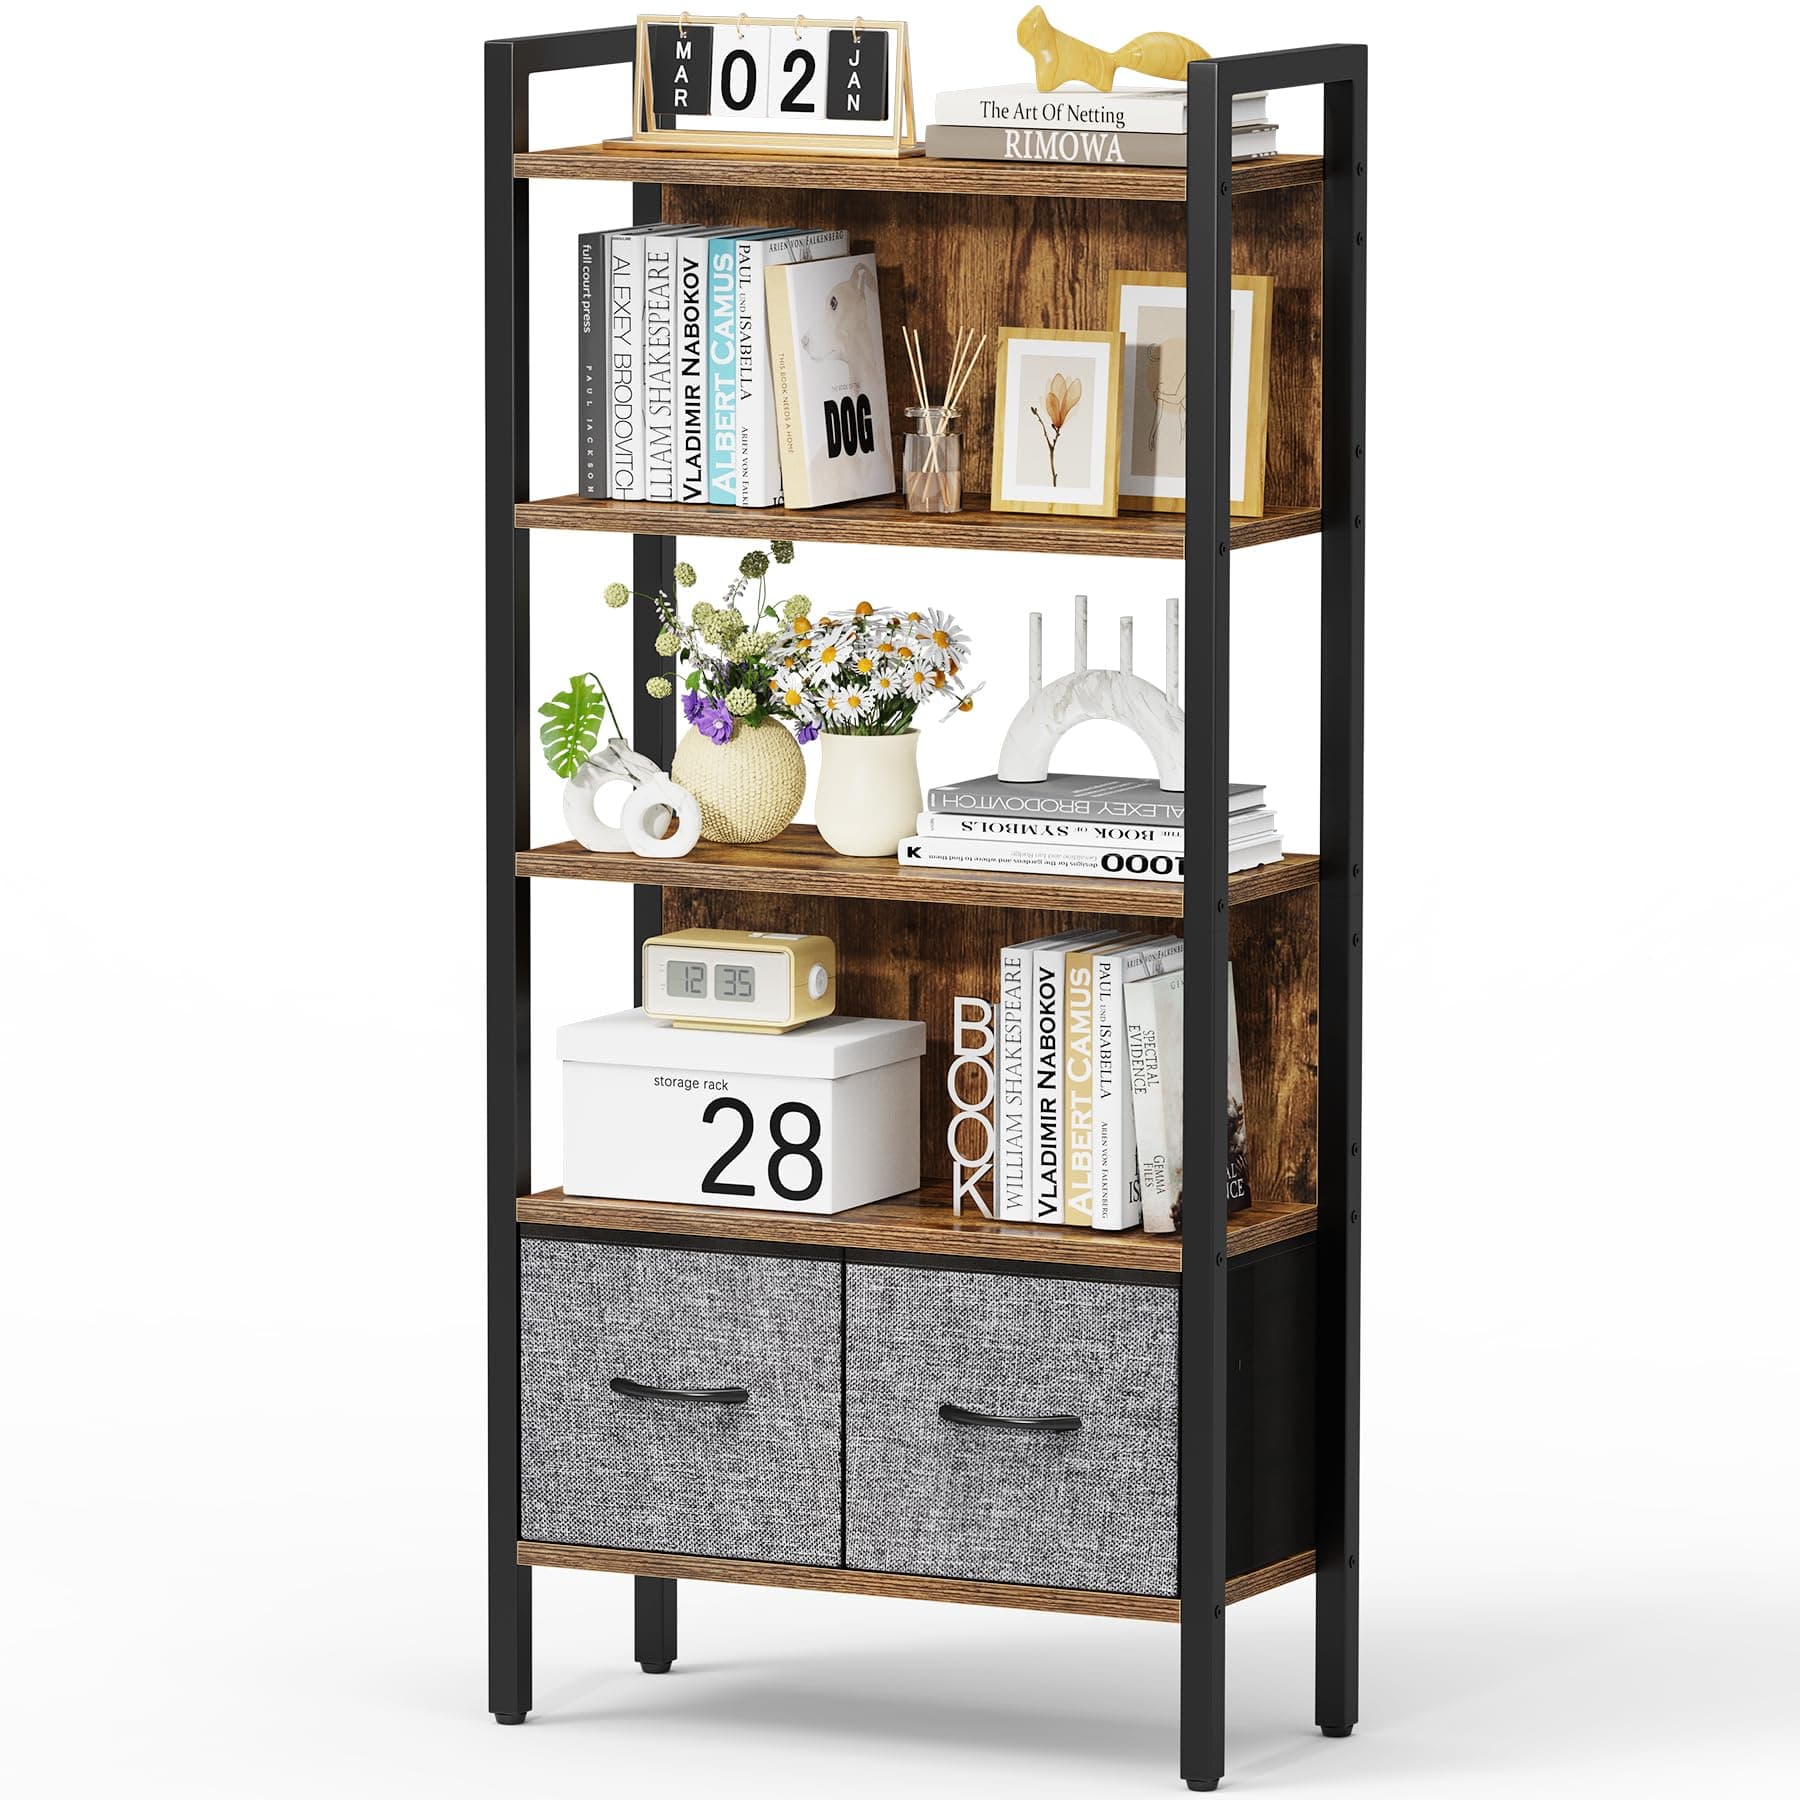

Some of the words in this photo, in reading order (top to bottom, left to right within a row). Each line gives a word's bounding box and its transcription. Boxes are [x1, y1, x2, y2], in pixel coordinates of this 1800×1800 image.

[674, 41, 692, 107] MAR
[847, 50, 861, 112] JAN
[980, 100, 1009, 120] The
[1013, 101, 1038, 121] Art
[1042, 103, 1064, 122] Of
[1067, 104, 1125, 129] Netting
[1004, 128, 1125, 163] RIMOWA
[582, 244, 592, 264] full
[582, 266, 592, 298] court
[739, 245, 751, 289] PAUL
[581, 300, 591, 333] press
[613, 255, 631, 345] ALEXEY
[681, 256, 700, 377] NABOKOV
[710, 253, 735, 365] CAMUS
[648, 252, 671, 416] SHAKESPEARE
[740, 316, 753, 401] ISABELLA
[683, 385, 702, 501] VLADIMIR
[712, 373, 736, 497] ALBERT
[824, 394, 875, 459] DOG
[943, 793, 1089, 814] BRODOVITCH
[961, 821, 1069, 837] SYMBOLS
[1094, 827, 1155, 841] BOOK
[1098, 801, 1184, 818] ALEXEY
[907, 846, 922, 858] K
[685, 965, 704, 993] 12
[723, 968, 752, 997] 35
[1099, 963, 1111, 1001] PAUL
[1004, 957, 1022, 1106] SHAKESPEARE
[1037, 966, 1056, 1089] NABOKOV
[1067, 968, 1092, 1083] CAMUS
[654, 1076, 699, 1091] storage
[703, 1079, 728, 1091] rack
[1100, 1025, 1112, 1099] ISABELLA
[1129, 1025, 1147, 1094] EVIDENCE
[1143, 1030, 1160, 1087] SPECTRAL
[947, 996, 995, 1217] BOOK
[701, 1097, 823, 1201] 28
[1006, 1114, 1023, 1209] WILLIAM
[1038, 1097, 1057, 1217] VLADIMIR
[1068, 1090, 1092, 1217] ALBERT
[1144, 1163, 1153, 1188] FILES
[1153, 1155, 1166, 1195] GEMMA
